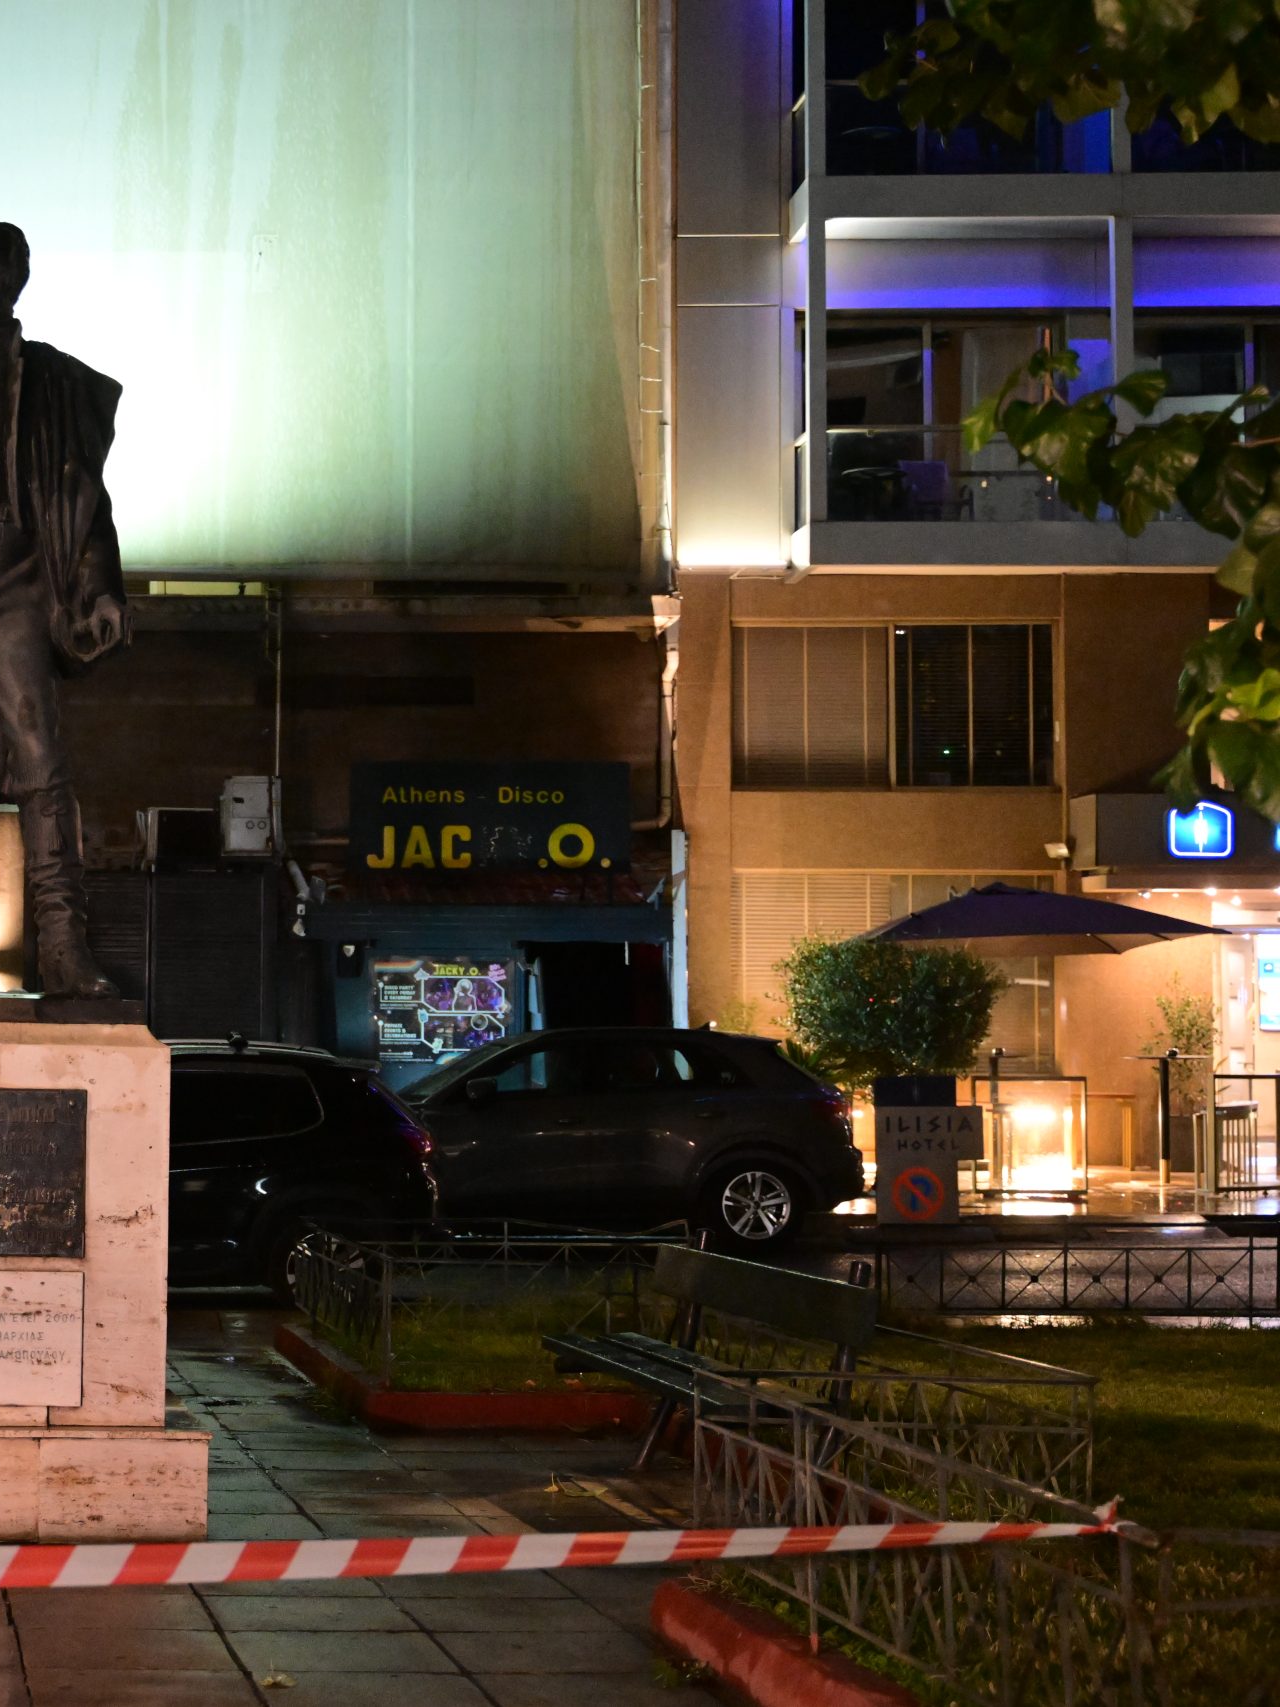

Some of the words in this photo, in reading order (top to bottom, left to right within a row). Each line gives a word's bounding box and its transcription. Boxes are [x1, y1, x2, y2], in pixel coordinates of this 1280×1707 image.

[382, 786, 465, 803] Athens
[498, 786, 564, 803] Disco
[886, 1116, 973, 1133] ILISIA
[897, 1139, 960, 1152] HOTEL
